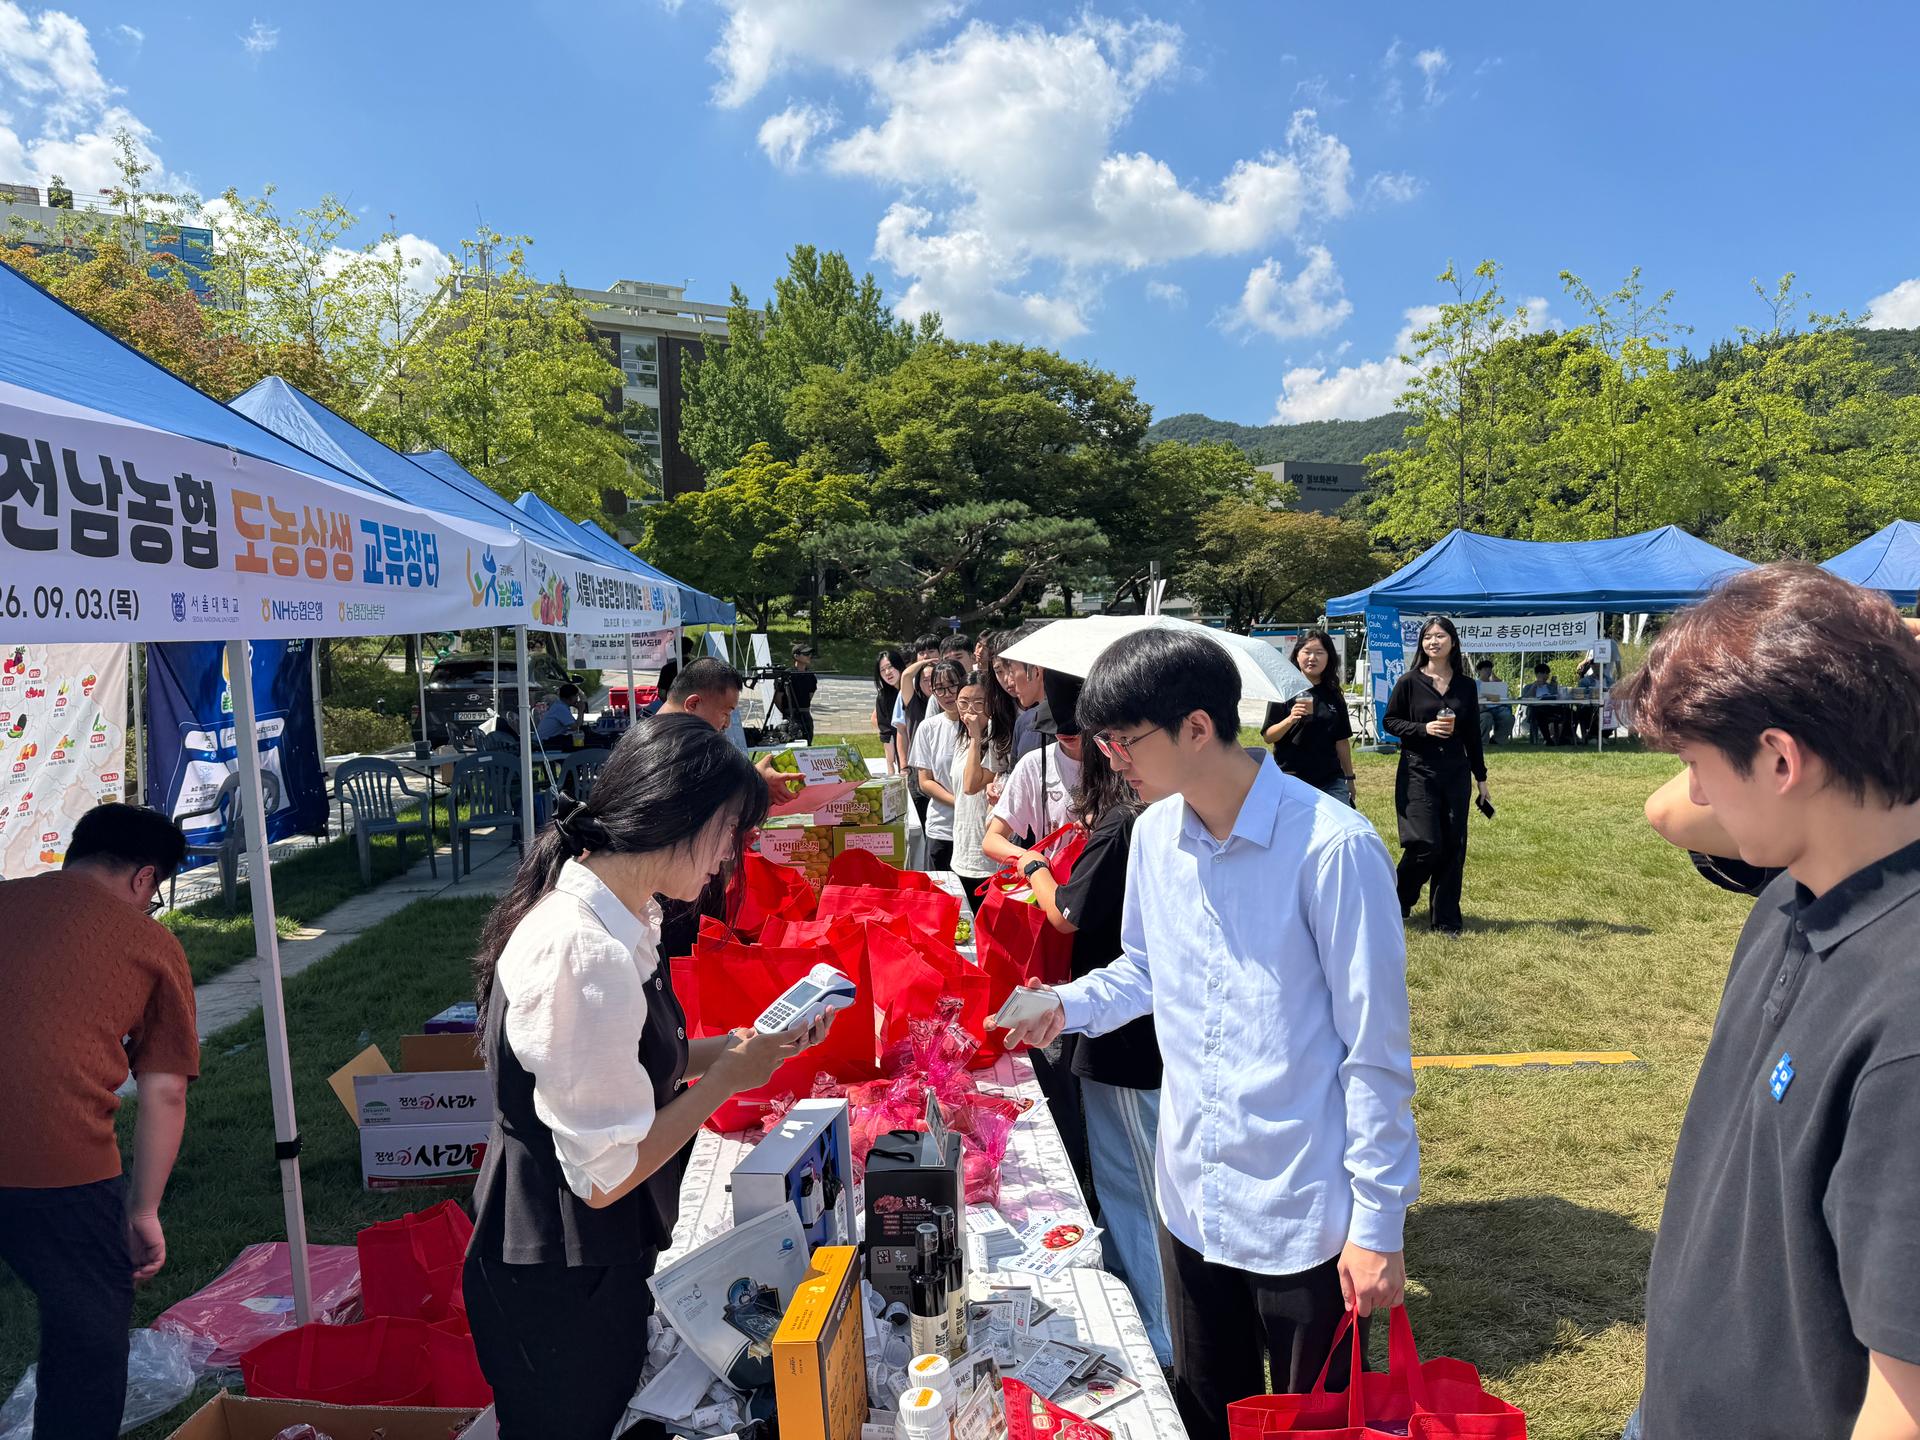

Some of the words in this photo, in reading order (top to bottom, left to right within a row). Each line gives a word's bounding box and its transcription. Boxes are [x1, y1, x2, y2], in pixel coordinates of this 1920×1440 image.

[0, 433, 219, 570] 전남농협
[231, 488, 353, 581] 도농상생
[360, 519, 439, 588] 교류장터
[0, 585, 28, 620] 6.
[34, 586, 70, 620] 09.
[191, 595, 239, 614] 서울대학교
[272, 600, 323, 621] NH농협은행
[1497, 621, 1587, 639] 총동아리연합회
[1484, 641, 1516, 649] University
[1517, 640, 1541, 648] Student
[400, 1096, 417, 1107] 장성
[437, 1095, 477, 1109] 사과
[375, 1151, 394, 1162] 장성
[414, 1143, 479, 1167] 사과
